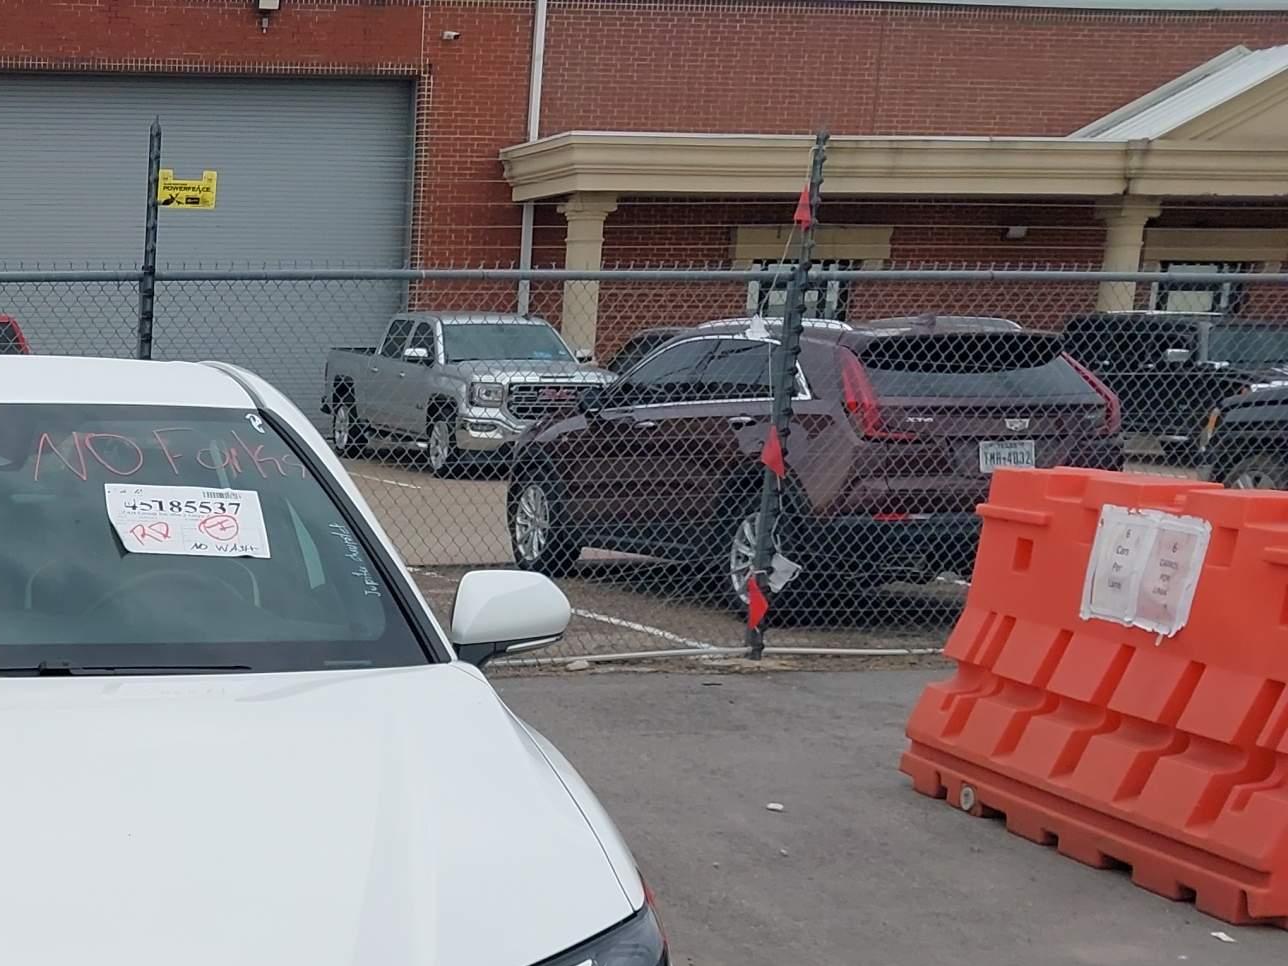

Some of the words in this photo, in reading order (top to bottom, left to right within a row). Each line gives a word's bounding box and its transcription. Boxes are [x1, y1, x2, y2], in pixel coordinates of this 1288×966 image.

[34, 431, 144, 481] NO
[124, 498, 240, 515] 45185537
[191, 542, 209, 551] NO
